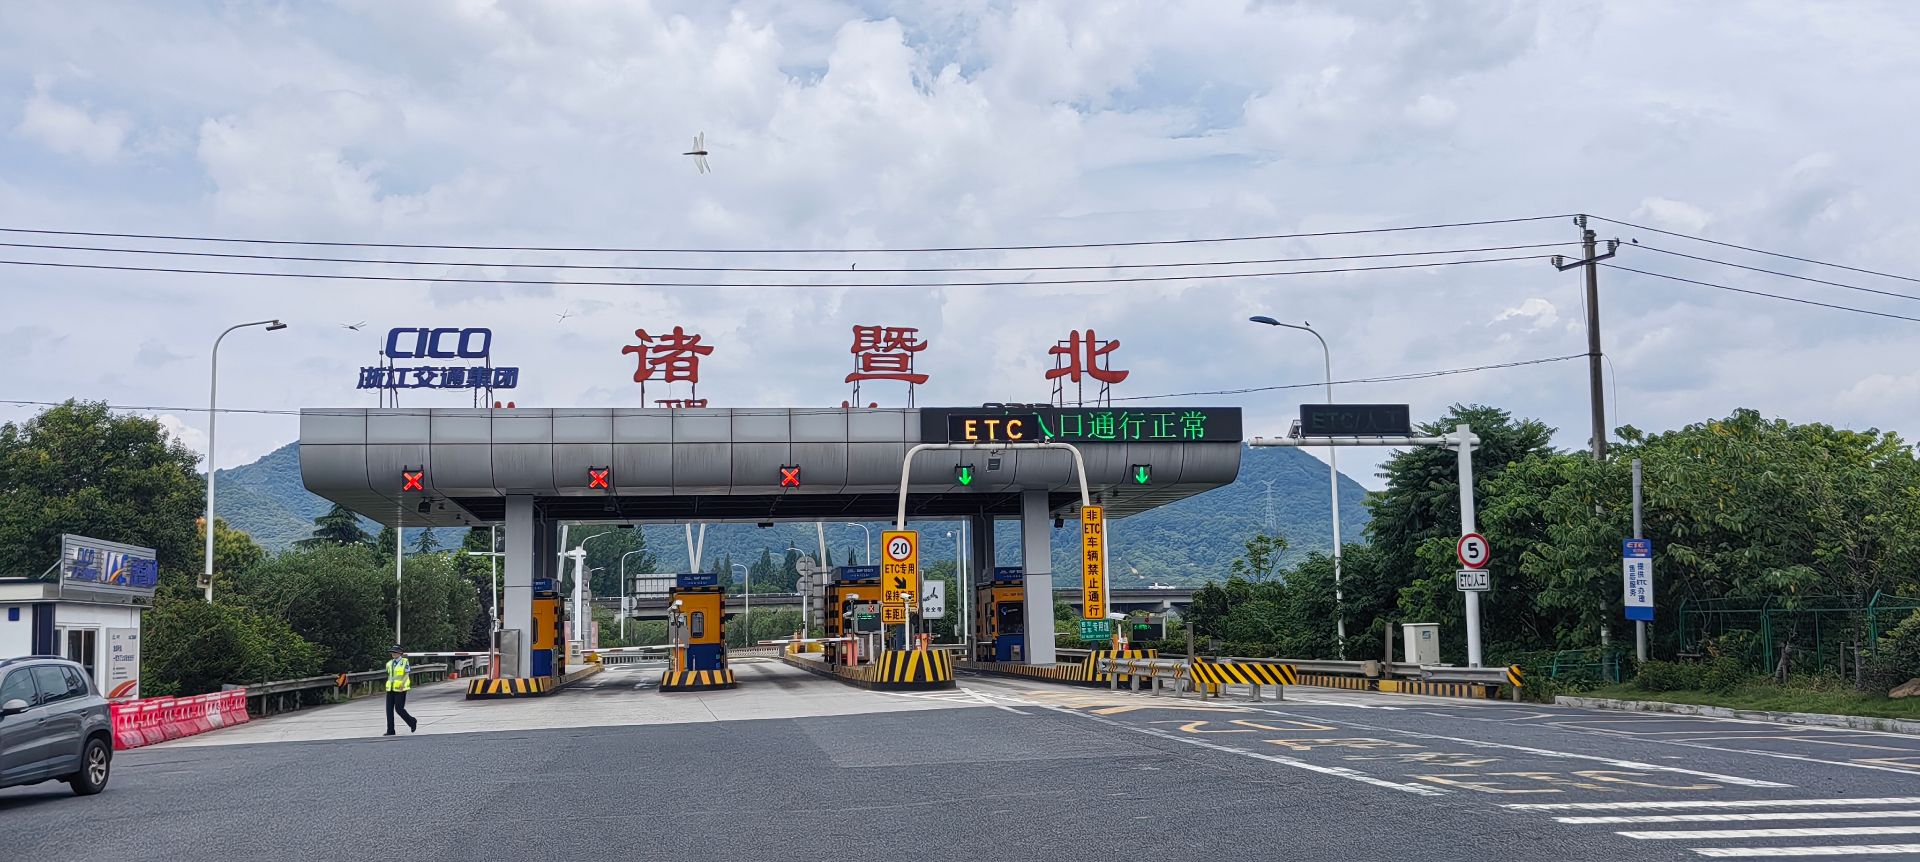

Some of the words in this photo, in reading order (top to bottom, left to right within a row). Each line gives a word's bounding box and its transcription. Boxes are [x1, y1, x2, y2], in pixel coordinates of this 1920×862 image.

[385, 327, 492, 358] CICO
[622, 325, 1130, 384] 诸暨北
[356, 366, 519, 389] 浙江交通集团
[965, 419, 1023, 440] ETC
[892, 542, 908, 555] 20
[1467, 542, 1479, 559] 5
[885, 563, 915, 574] ETC专用
[1084, 509, 1101, 616] 非ETC车辆禁止通行
[1460, 573, 1486, 587] ETC/人工
[885, 590, 915, 601] 保持距
